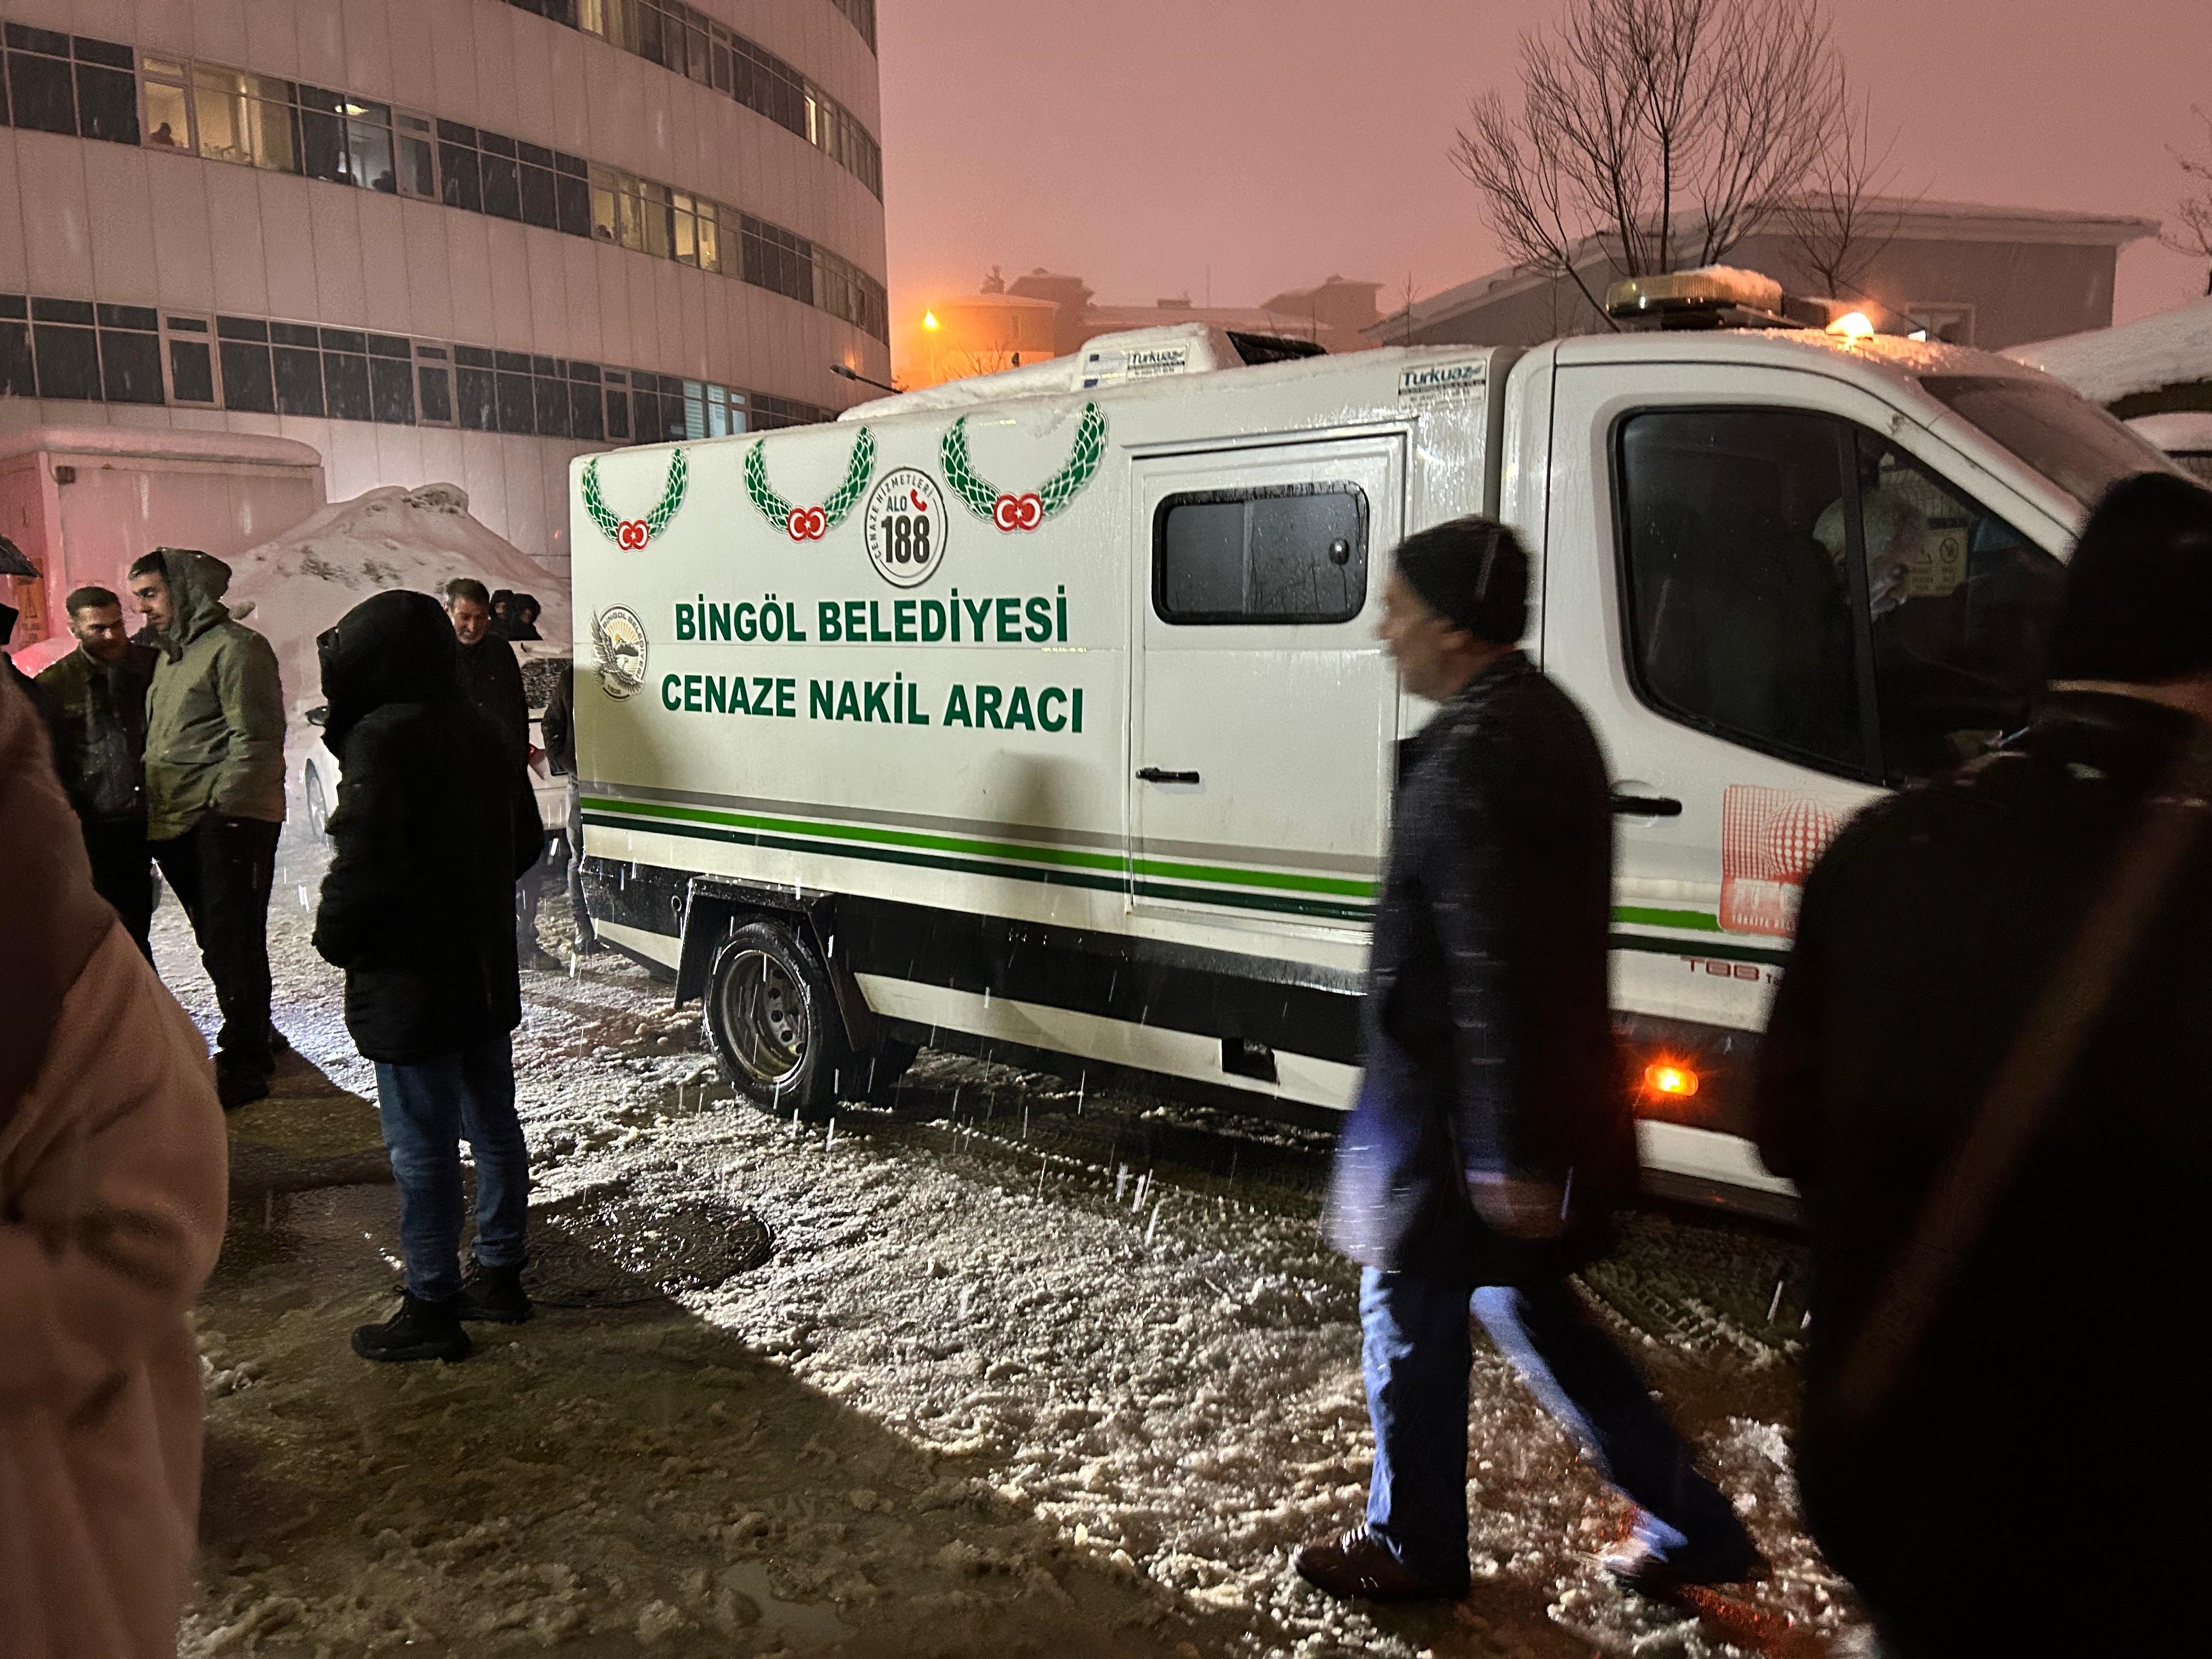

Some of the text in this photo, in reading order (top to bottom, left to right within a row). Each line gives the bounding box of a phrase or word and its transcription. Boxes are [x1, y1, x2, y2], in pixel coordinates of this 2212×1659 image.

[886, 495, 907, 512] ALO
[868, 506, 882, 560] CENAZE
[881, 515, 930, 564] 188
[675, 585, 1068, 642] BİNGÖL BELEDİYESİ
[662, 672, 1083, 733] CENAZE NAKİL ARACI
